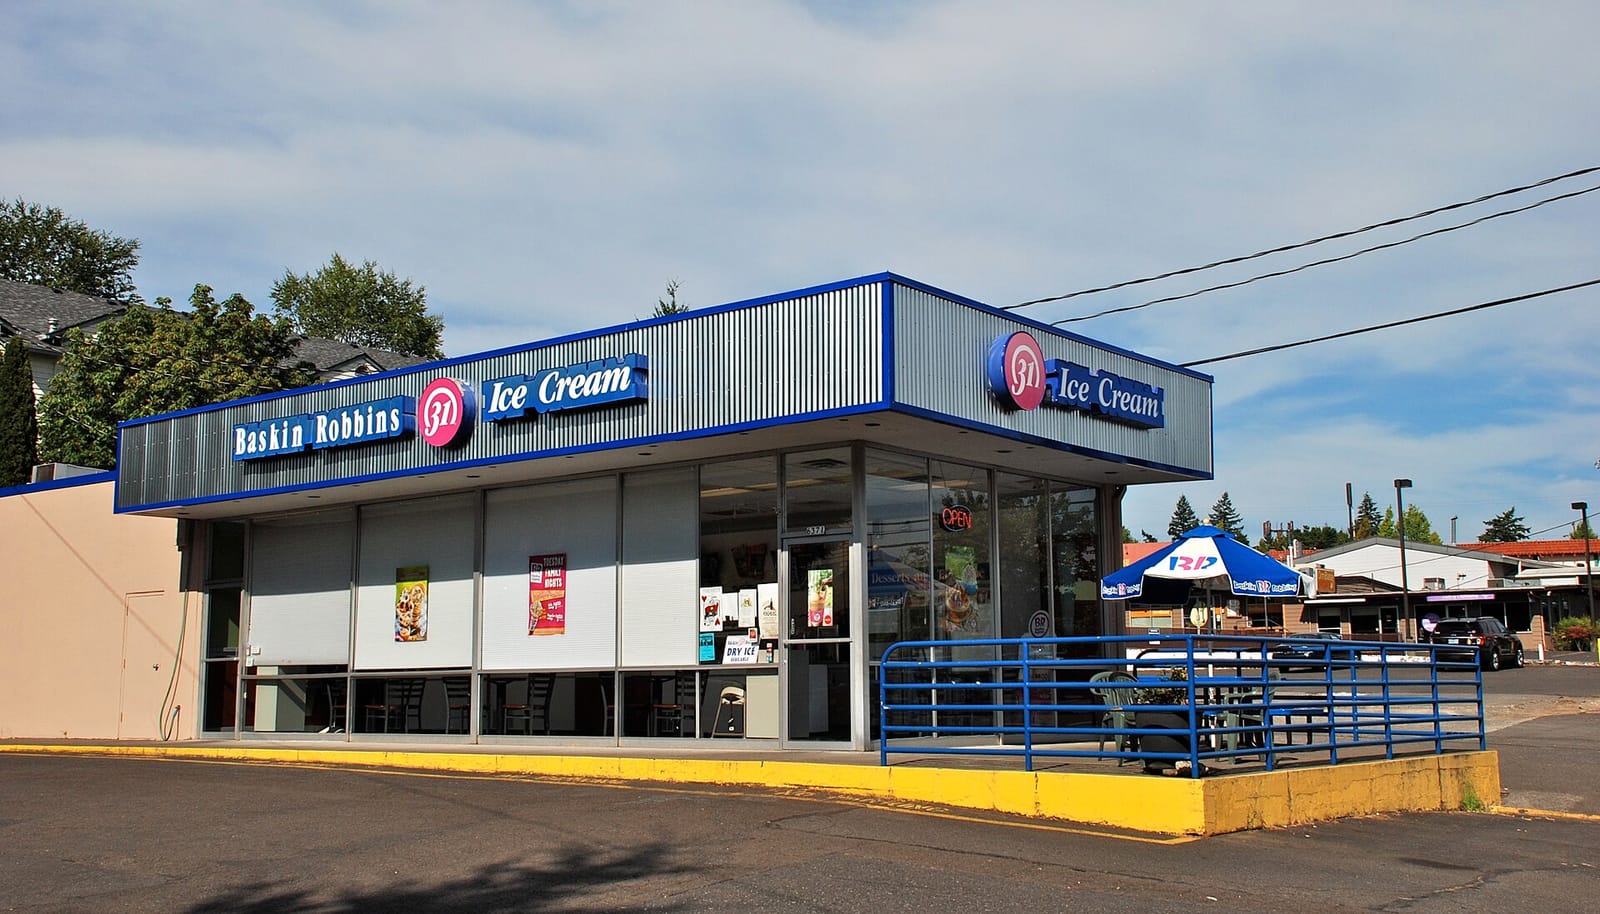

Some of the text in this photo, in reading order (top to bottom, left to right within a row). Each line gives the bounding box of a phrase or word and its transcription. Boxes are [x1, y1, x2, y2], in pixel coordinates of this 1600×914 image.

[487, 365, 631, 413] Ice Cream
[1011, 358, 1035, 396] 31
[1058, 368, 1159, 418] Ice Cream
[234, 405, 400, 456] Baskin Robbins
[424, 399, 454, 437] 31
[942, 507, 973, 529] OPEN
[871, 573, 910, 584] Desserts
[726, 646, 756, 657] DRY ICE
